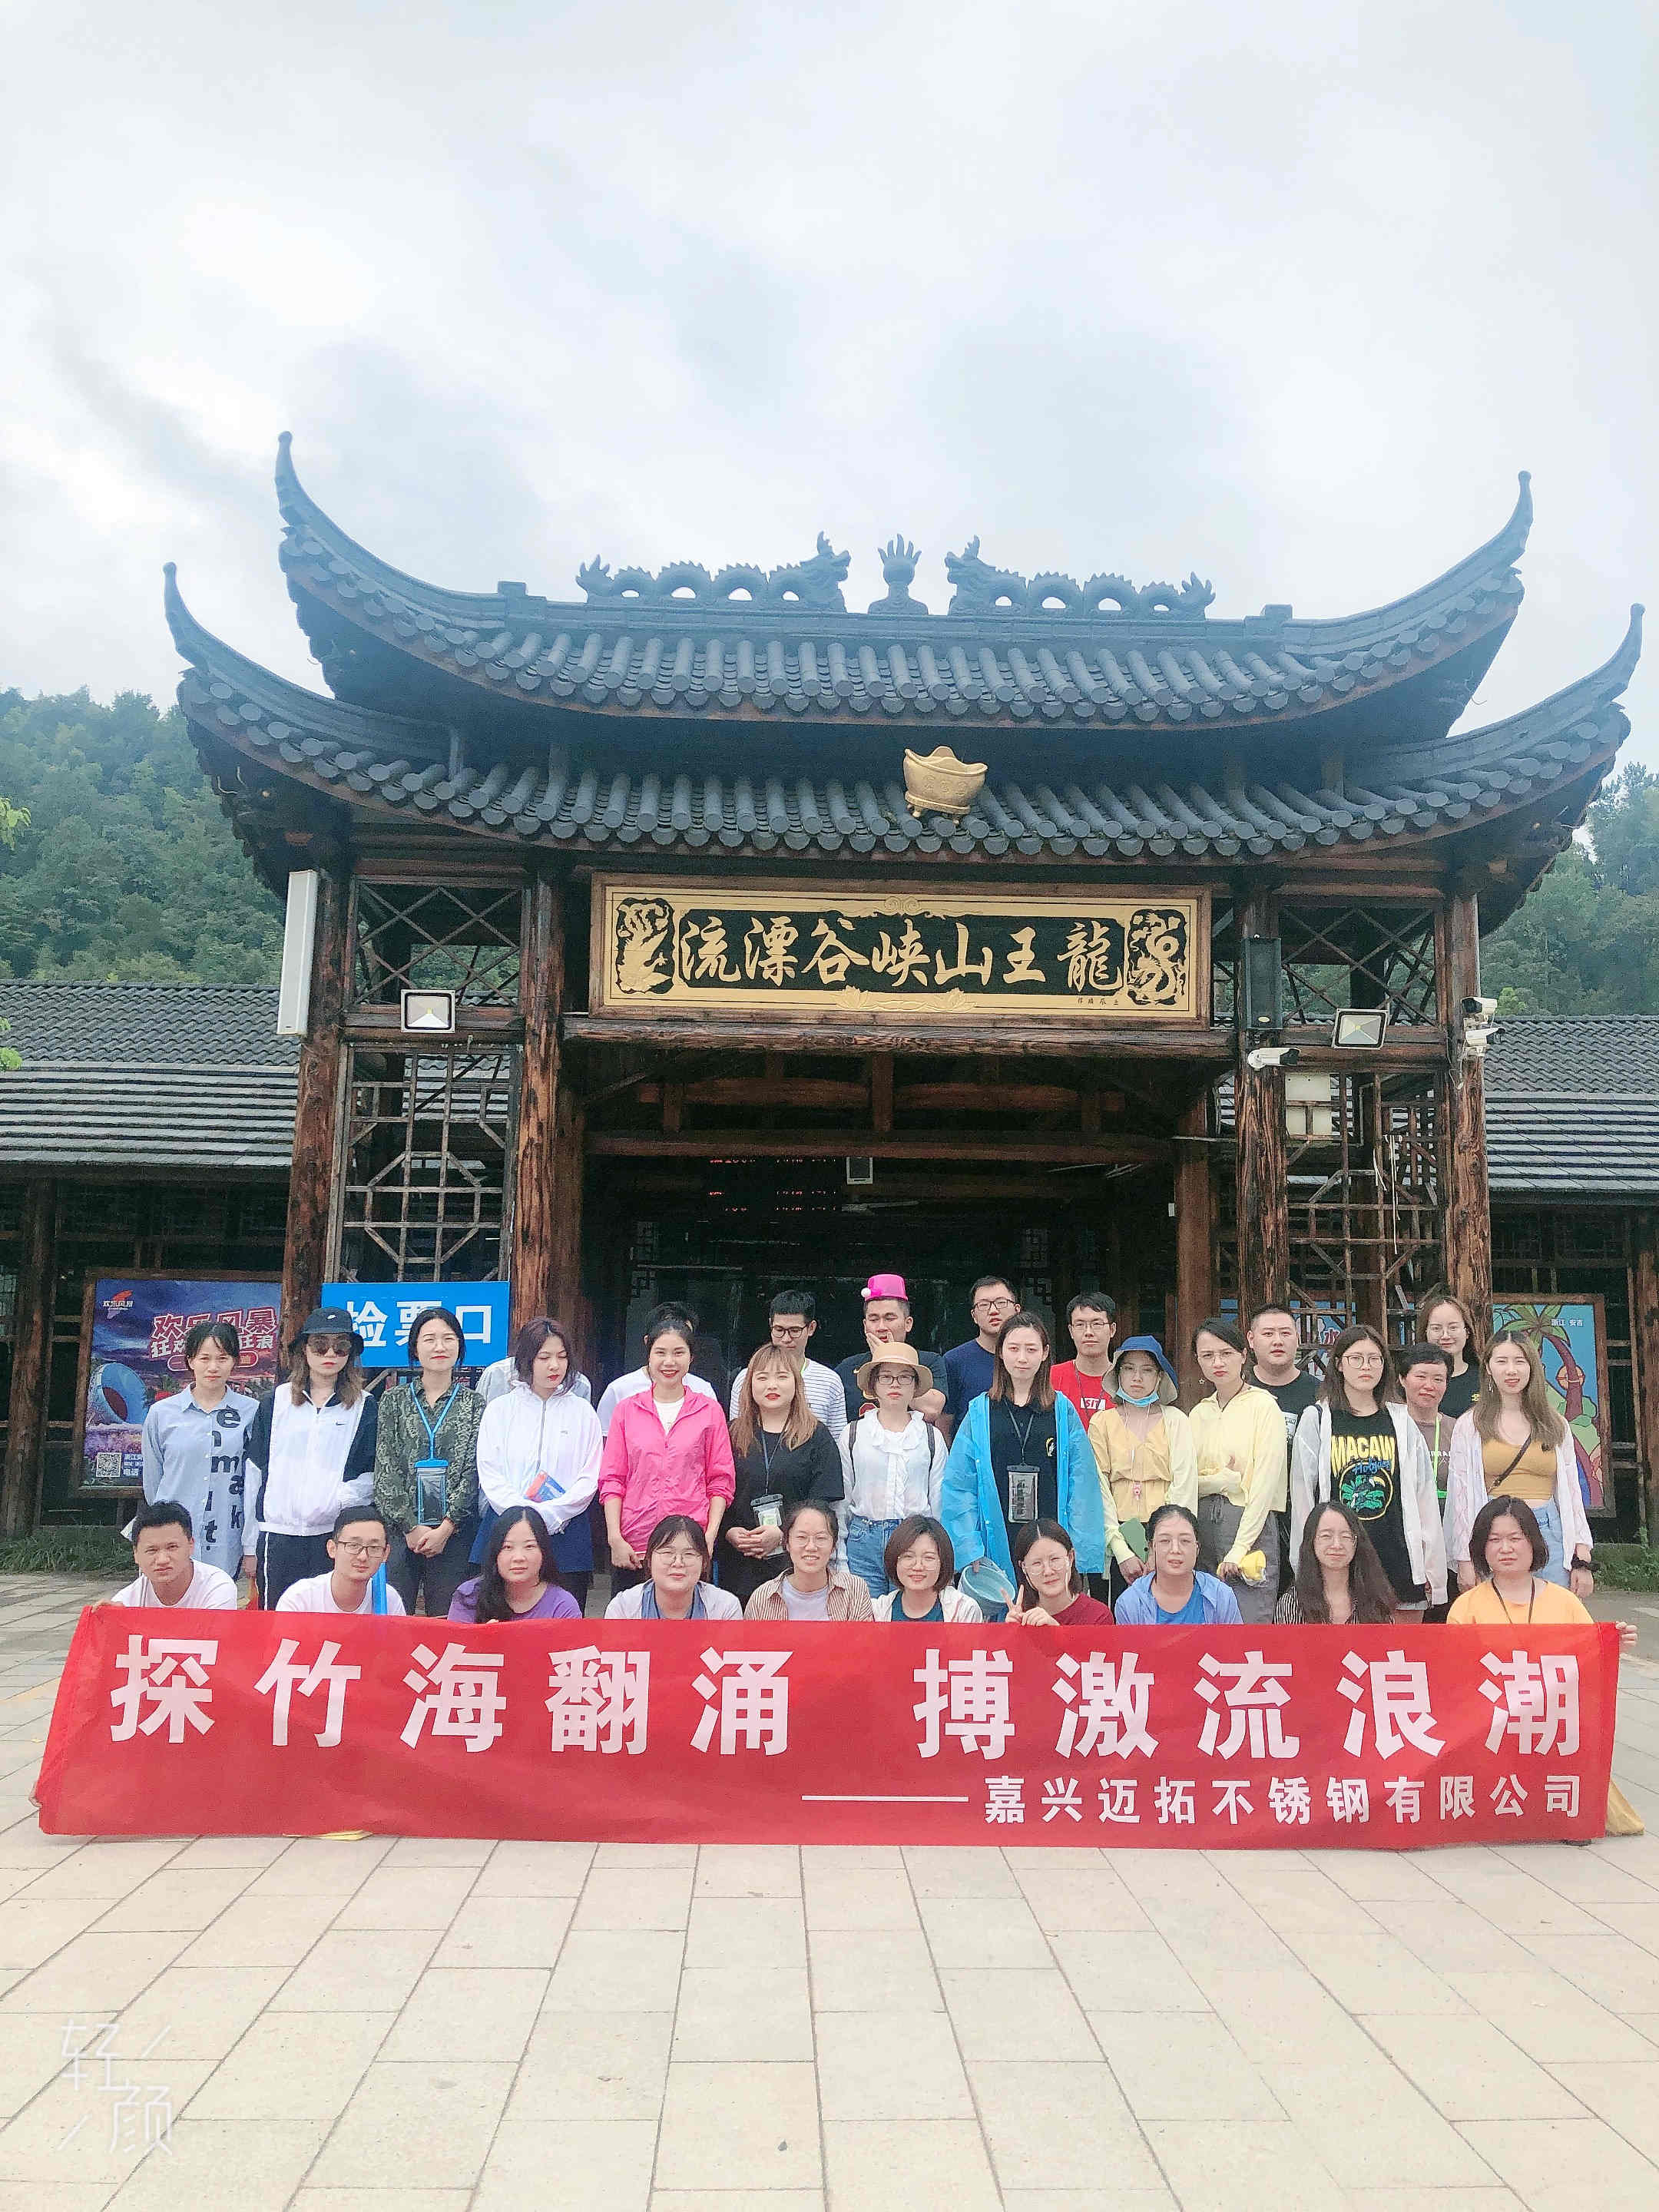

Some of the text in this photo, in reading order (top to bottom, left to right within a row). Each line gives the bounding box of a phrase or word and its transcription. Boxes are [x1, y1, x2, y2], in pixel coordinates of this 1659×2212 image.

[1331, 1434, 1396, 1479] MACAW
[109, 1633, 1581, 1760] 探竹海翻涌 搏激流浪潮
[983, 1773, 1581, 1826] 嘉兴迈拓不锈钢有限公司
